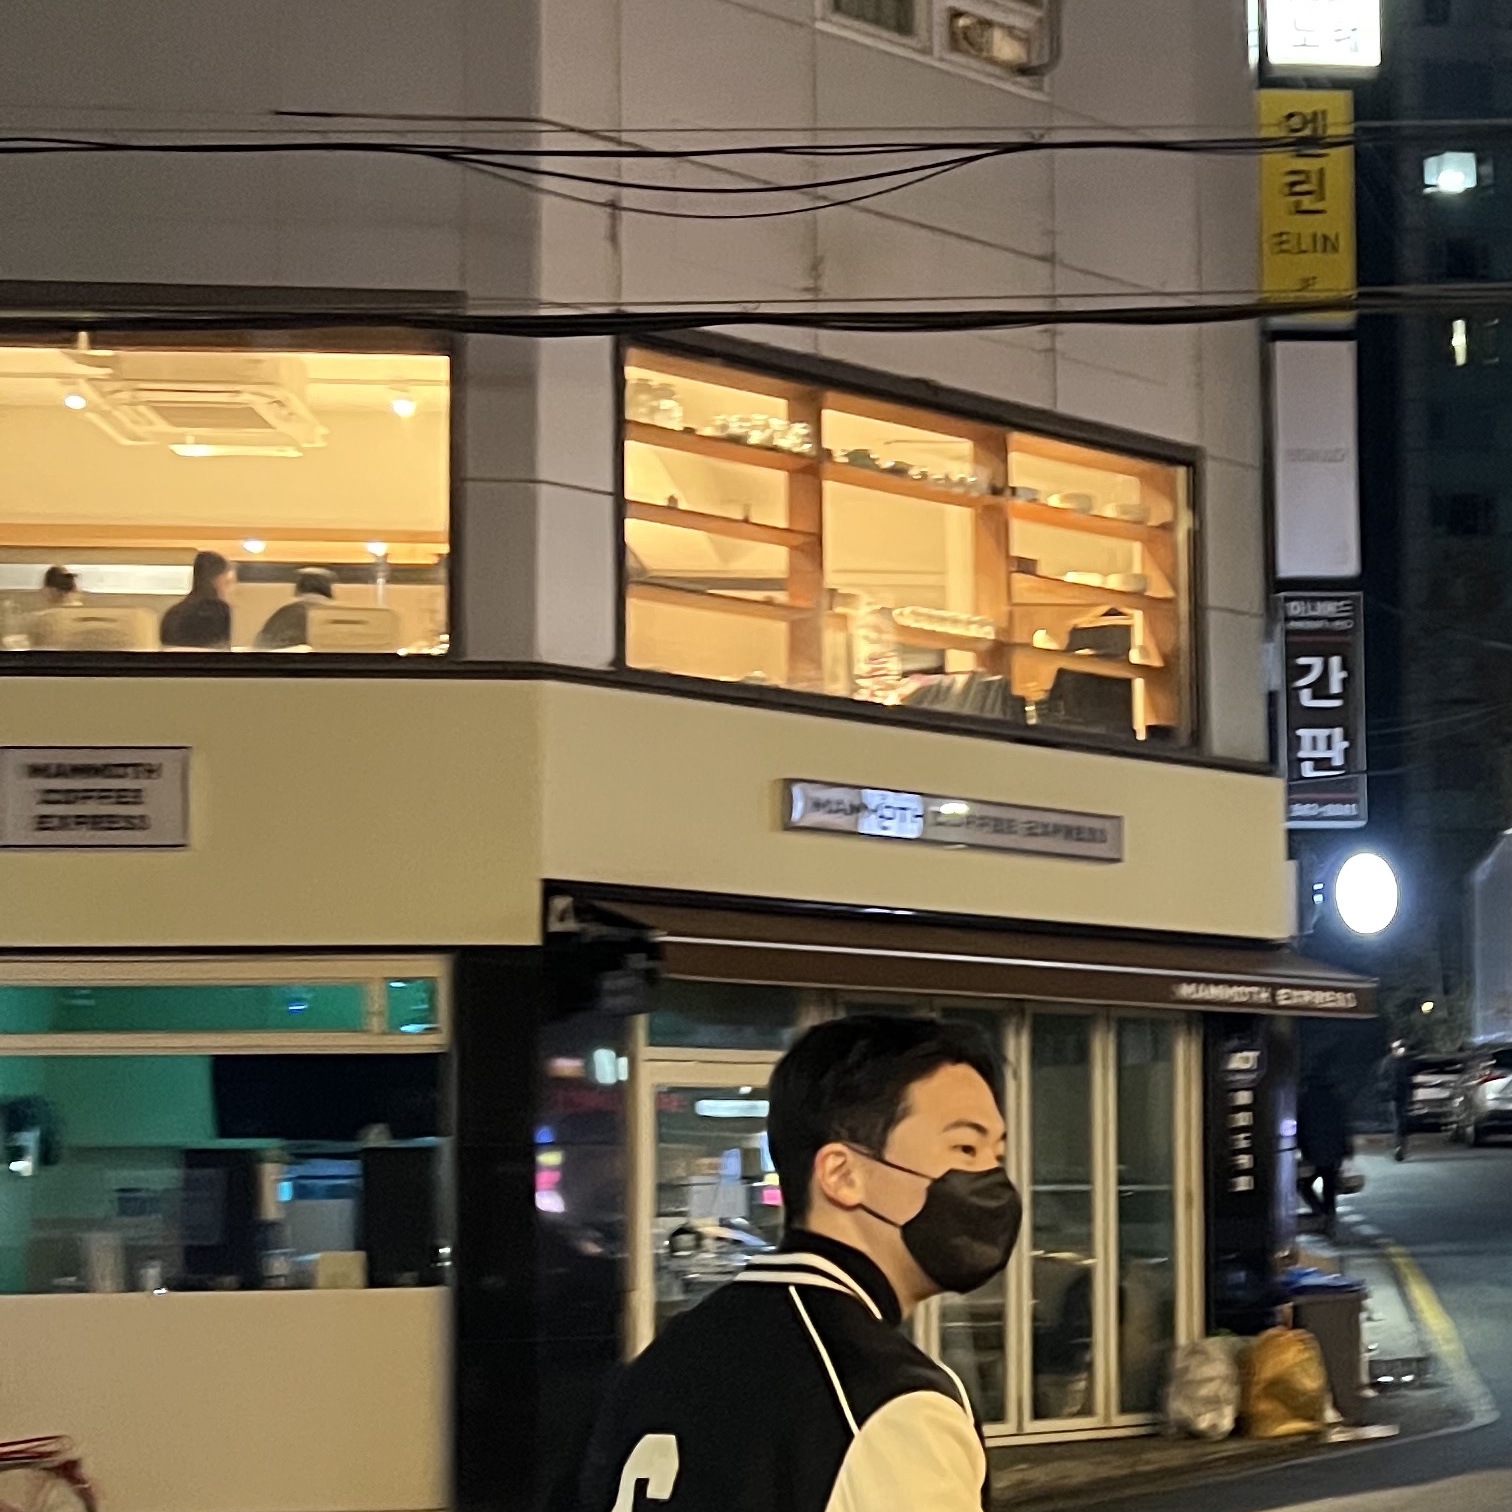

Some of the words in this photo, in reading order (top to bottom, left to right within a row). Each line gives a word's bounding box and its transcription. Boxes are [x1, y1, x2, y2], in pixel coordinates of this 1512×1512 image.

[1270, 231, 1340, 255] ELIN
[1292, 655, 1350, 778] 간판
[34, 814, 151, 831] EXPRESS
[1175, 982, 1273, 1004] MAMMOTH
[1275, 988, 1357, 1008] EXPRESS
